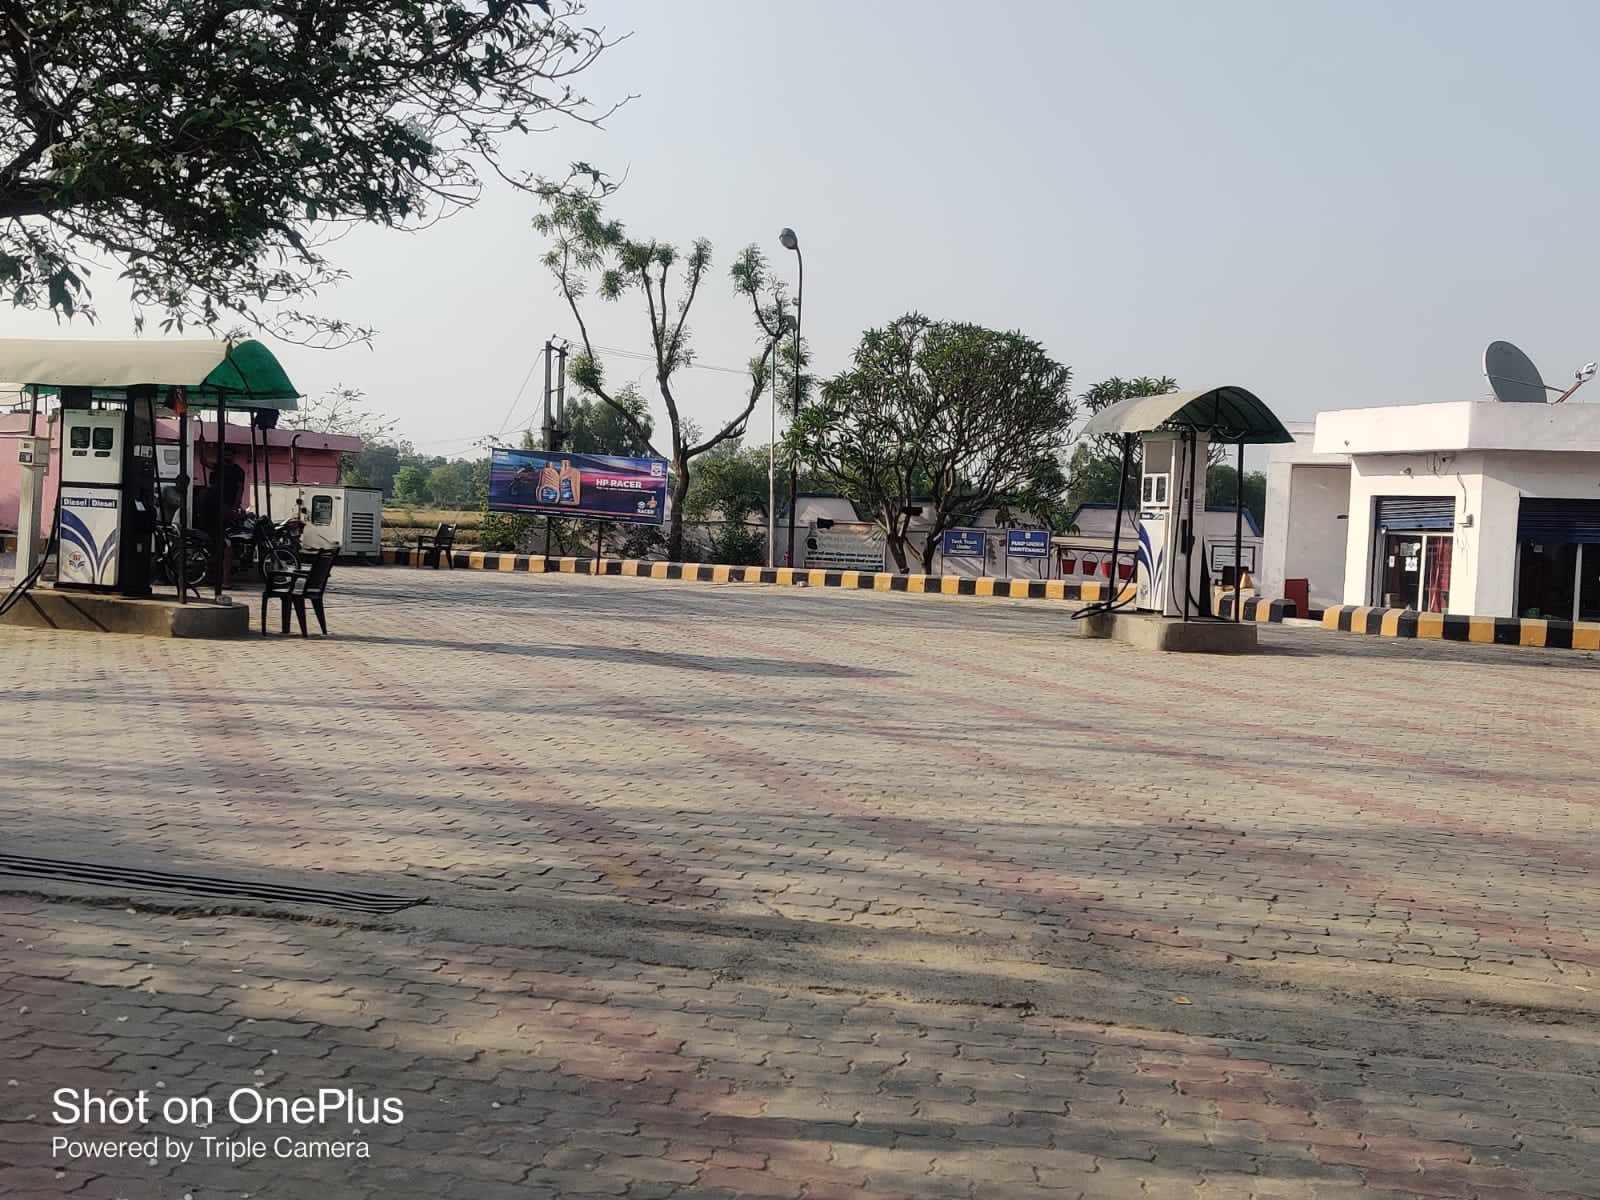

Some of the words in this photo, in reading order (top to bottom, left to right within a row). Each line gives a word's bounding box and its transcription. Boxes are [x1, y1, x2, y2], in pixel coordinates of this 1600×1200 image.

[596, 478, 609, 487] HP
[610, 479, 642, 489] RACER
[63, 498, 87, 506] Diesel
[91, 499, 115, 507] Diesel
